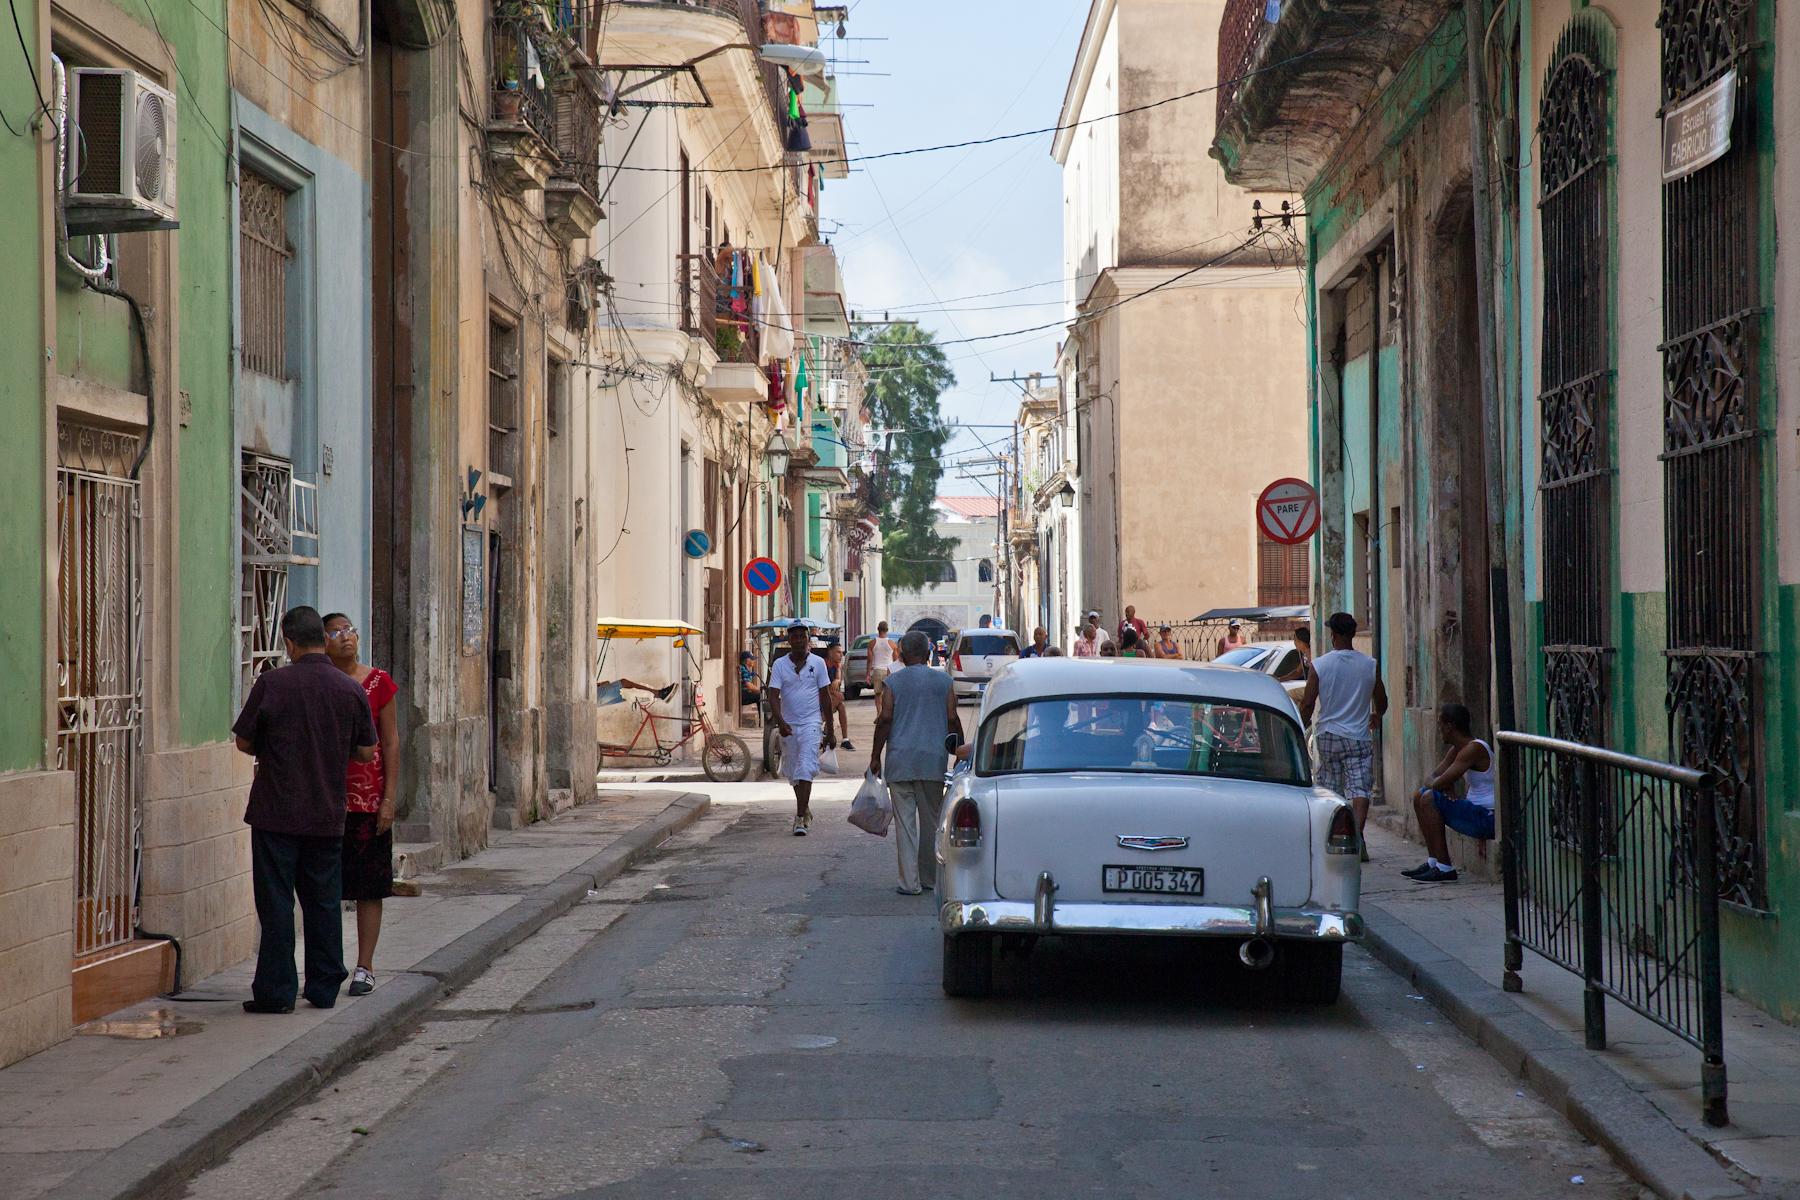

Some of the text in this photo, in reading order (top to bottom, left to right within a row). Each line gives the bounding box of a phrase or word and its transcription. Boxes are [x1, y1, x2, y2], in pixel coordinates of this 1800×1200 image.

[1681, 106, 1705, 135] Escuela
[1670, 128, 1707, 166] FABRICIO
[1276, 503, 1300, 515] PARE
[1118, 870, 1128, 889] P
[1132, 871, 1164, 890] 005
